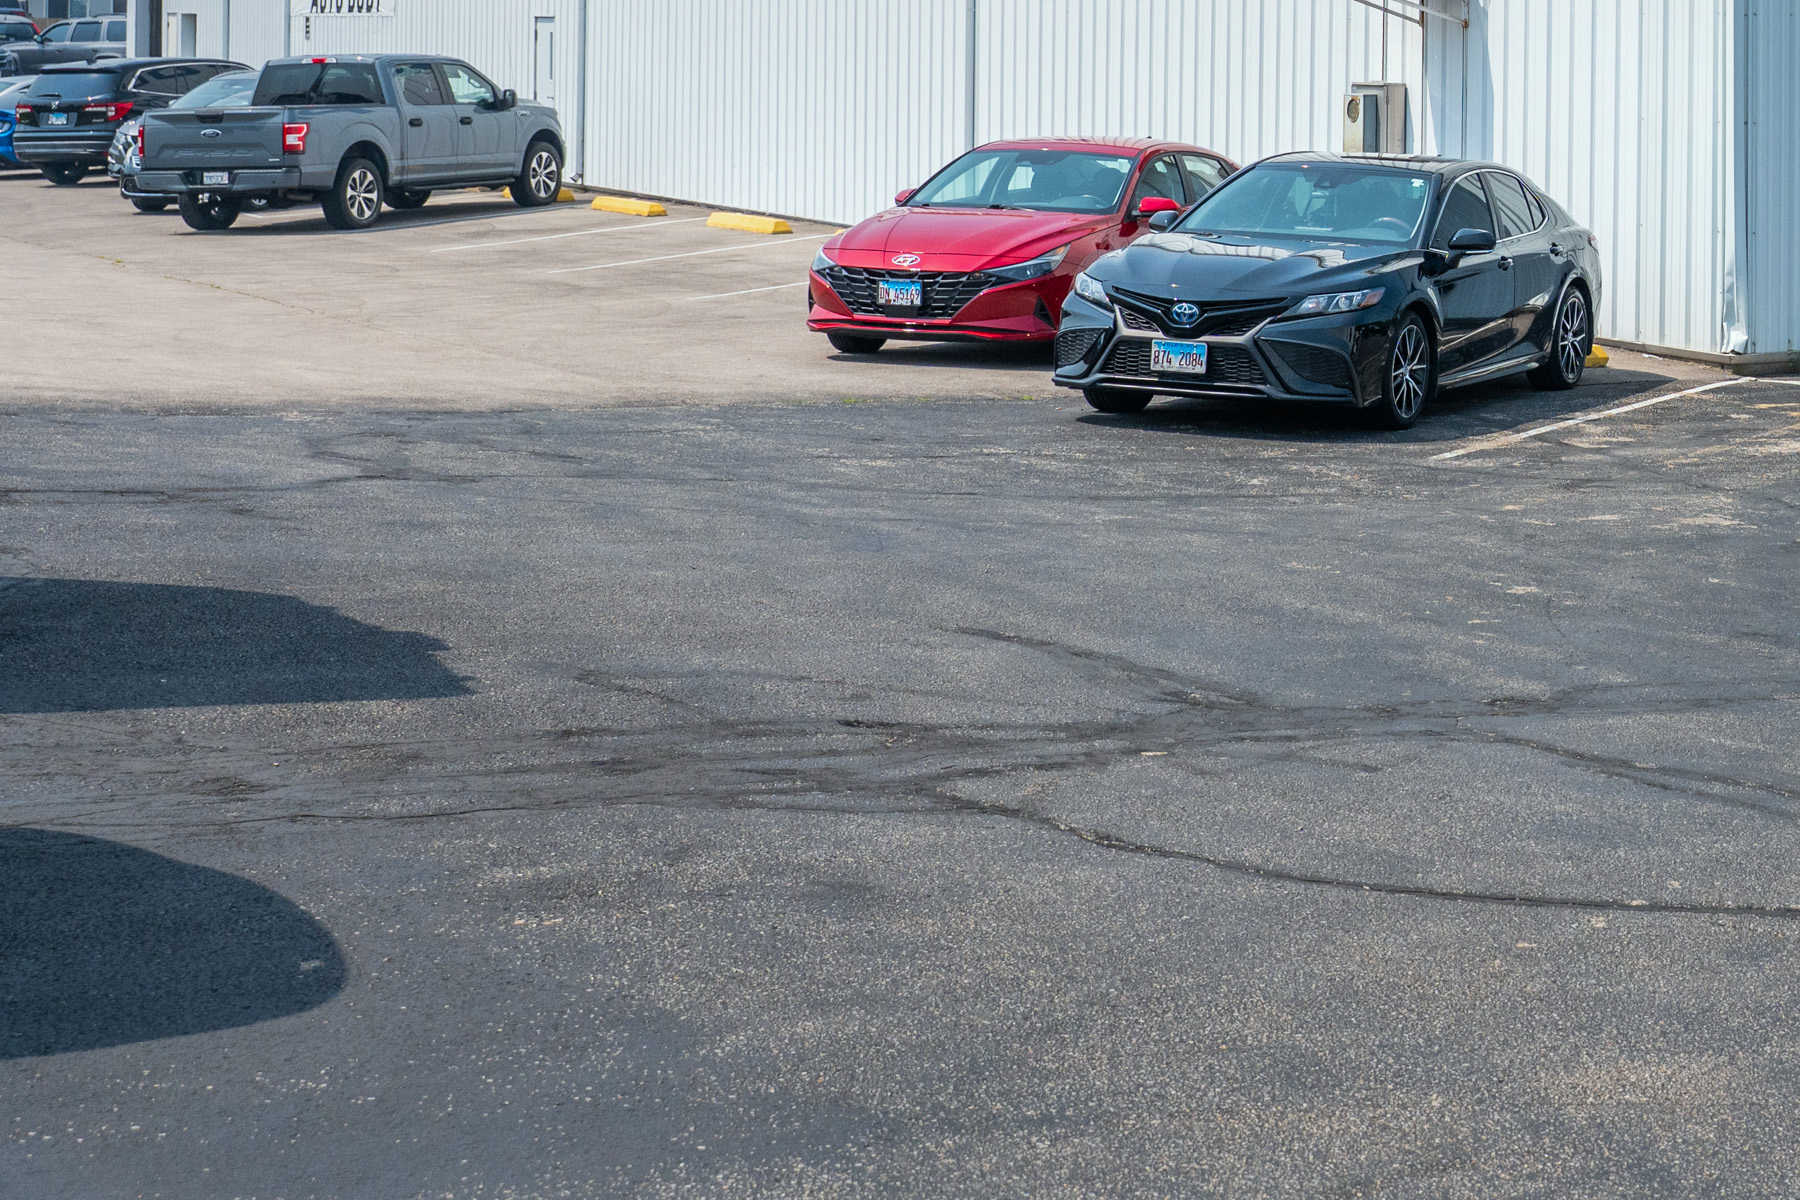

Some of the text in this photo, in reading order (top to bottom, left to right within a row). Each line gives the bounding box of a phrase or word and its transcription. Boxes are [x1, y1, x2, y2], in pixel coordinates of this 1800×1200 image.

[880, 287, 920, 301] DN 45169
[1153, 350, 1203, 368] 874 2084
